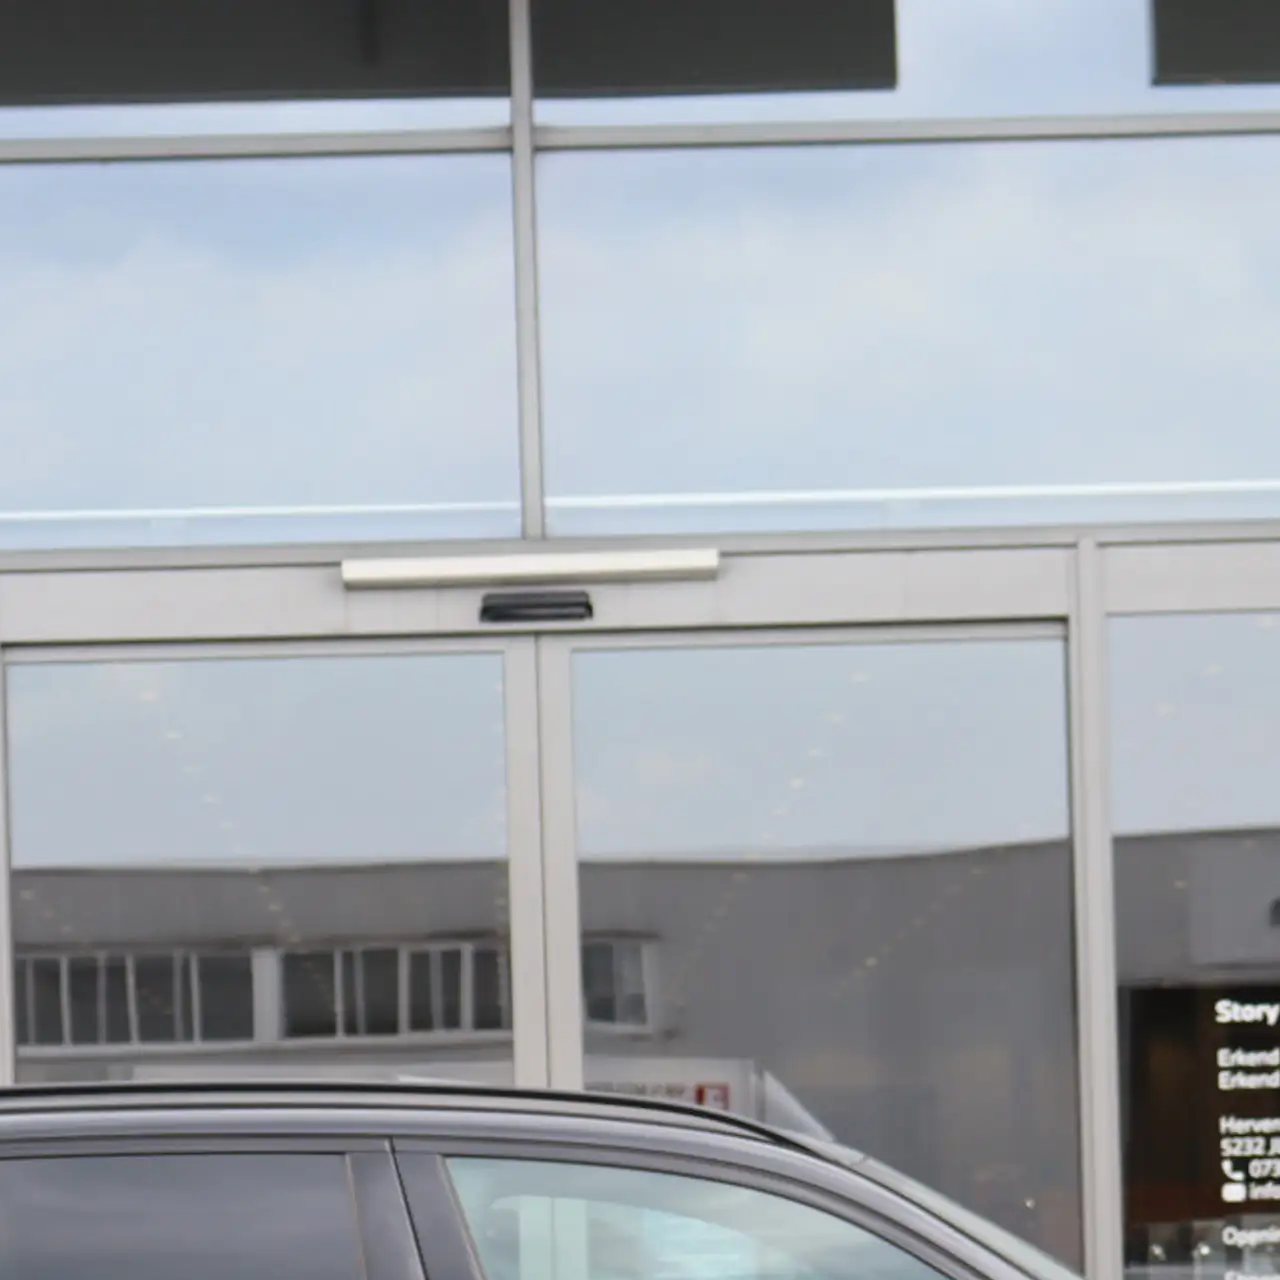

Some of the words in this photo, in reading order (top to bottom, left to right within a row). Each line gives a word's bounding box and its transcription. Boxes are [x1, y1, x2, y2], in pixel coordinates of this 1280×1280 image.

[1215, 999, 1280, 1026] Story
[1217, 1047, 1280, 1067] Erkend
[1218, 1070, 1280, 1090] Erkend
